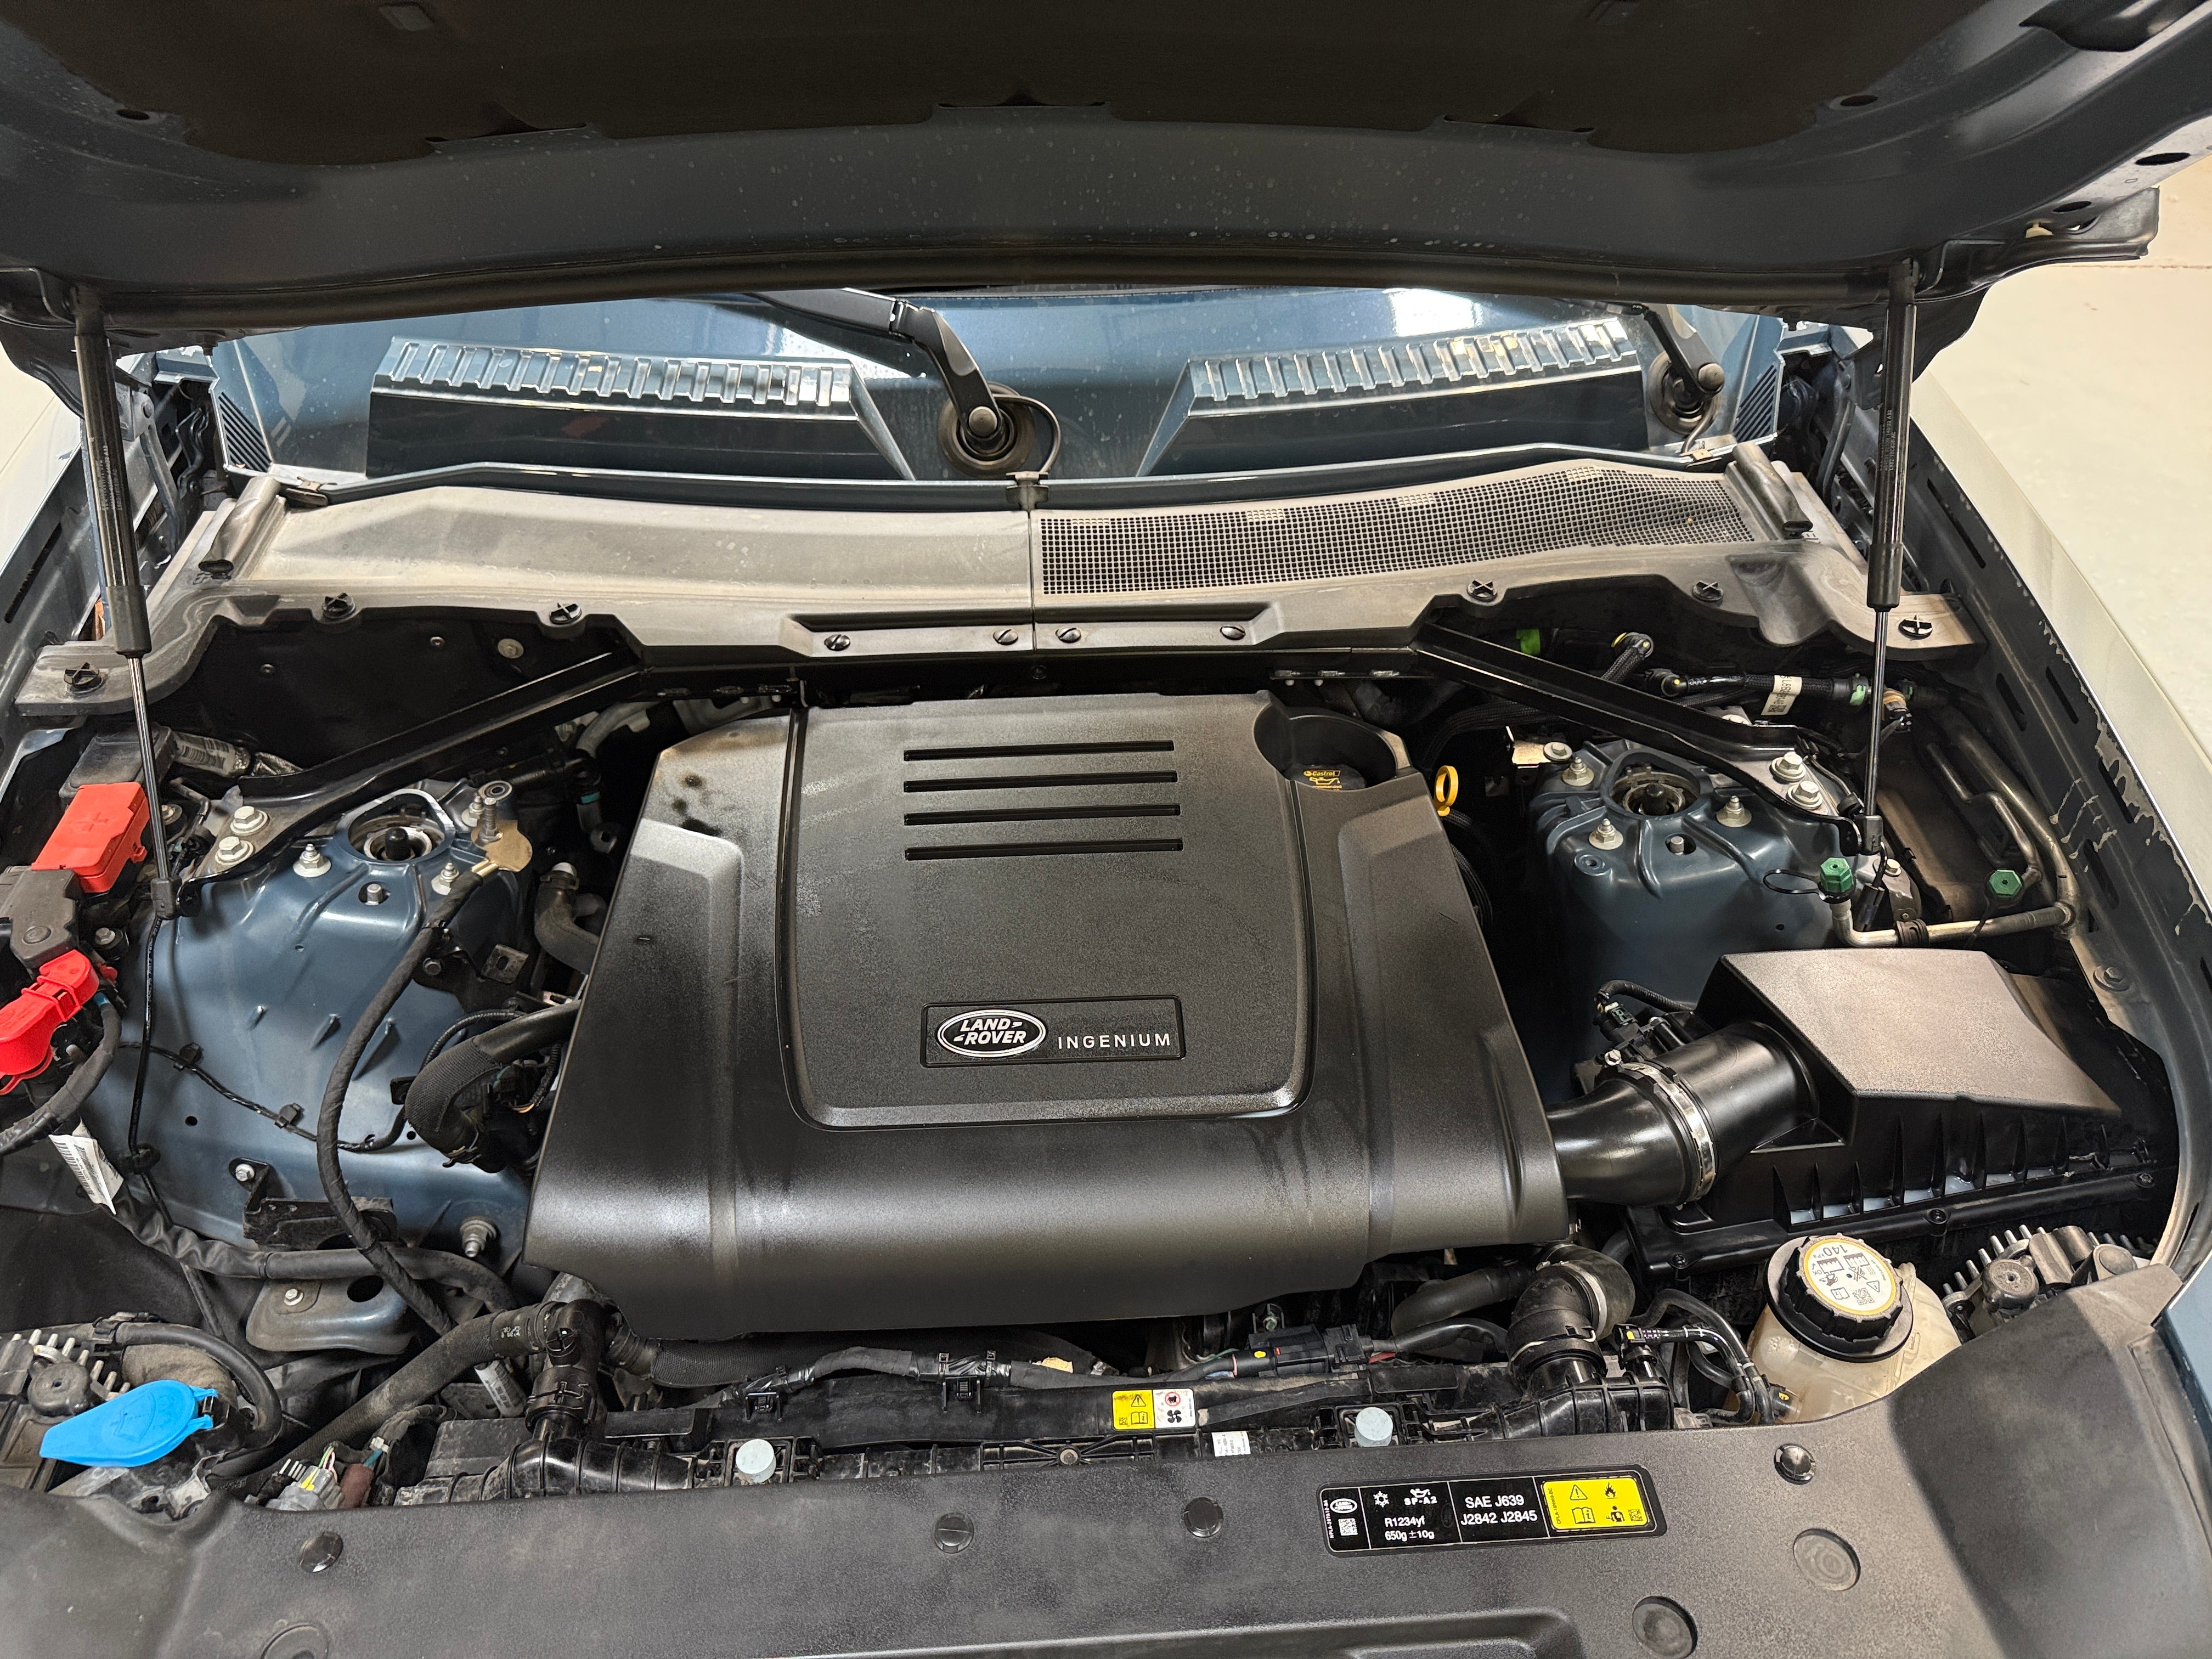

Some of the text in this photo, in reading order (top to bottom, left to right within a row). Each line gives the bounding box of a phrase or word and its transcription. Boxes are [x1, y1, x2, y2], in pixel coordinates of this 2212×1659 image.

[961, 1018, 1011, 1032] LAND
[963, 1030, 1027, 1046] ROVER
[1058, 1032, 1171, 1049] INGENIUM
[1822, 1244, 1848, 1257] 140
[1404, 1496, 1438, 1505] SP-A2
[1465, 1494, 1525, 1509] SAE J639
[1384, 1515, 1425, 1527] R1234yf
[1460, 1510, 1538, 1526] J2842 J2845
[1385, 1531, 1407, 1542] 650g
